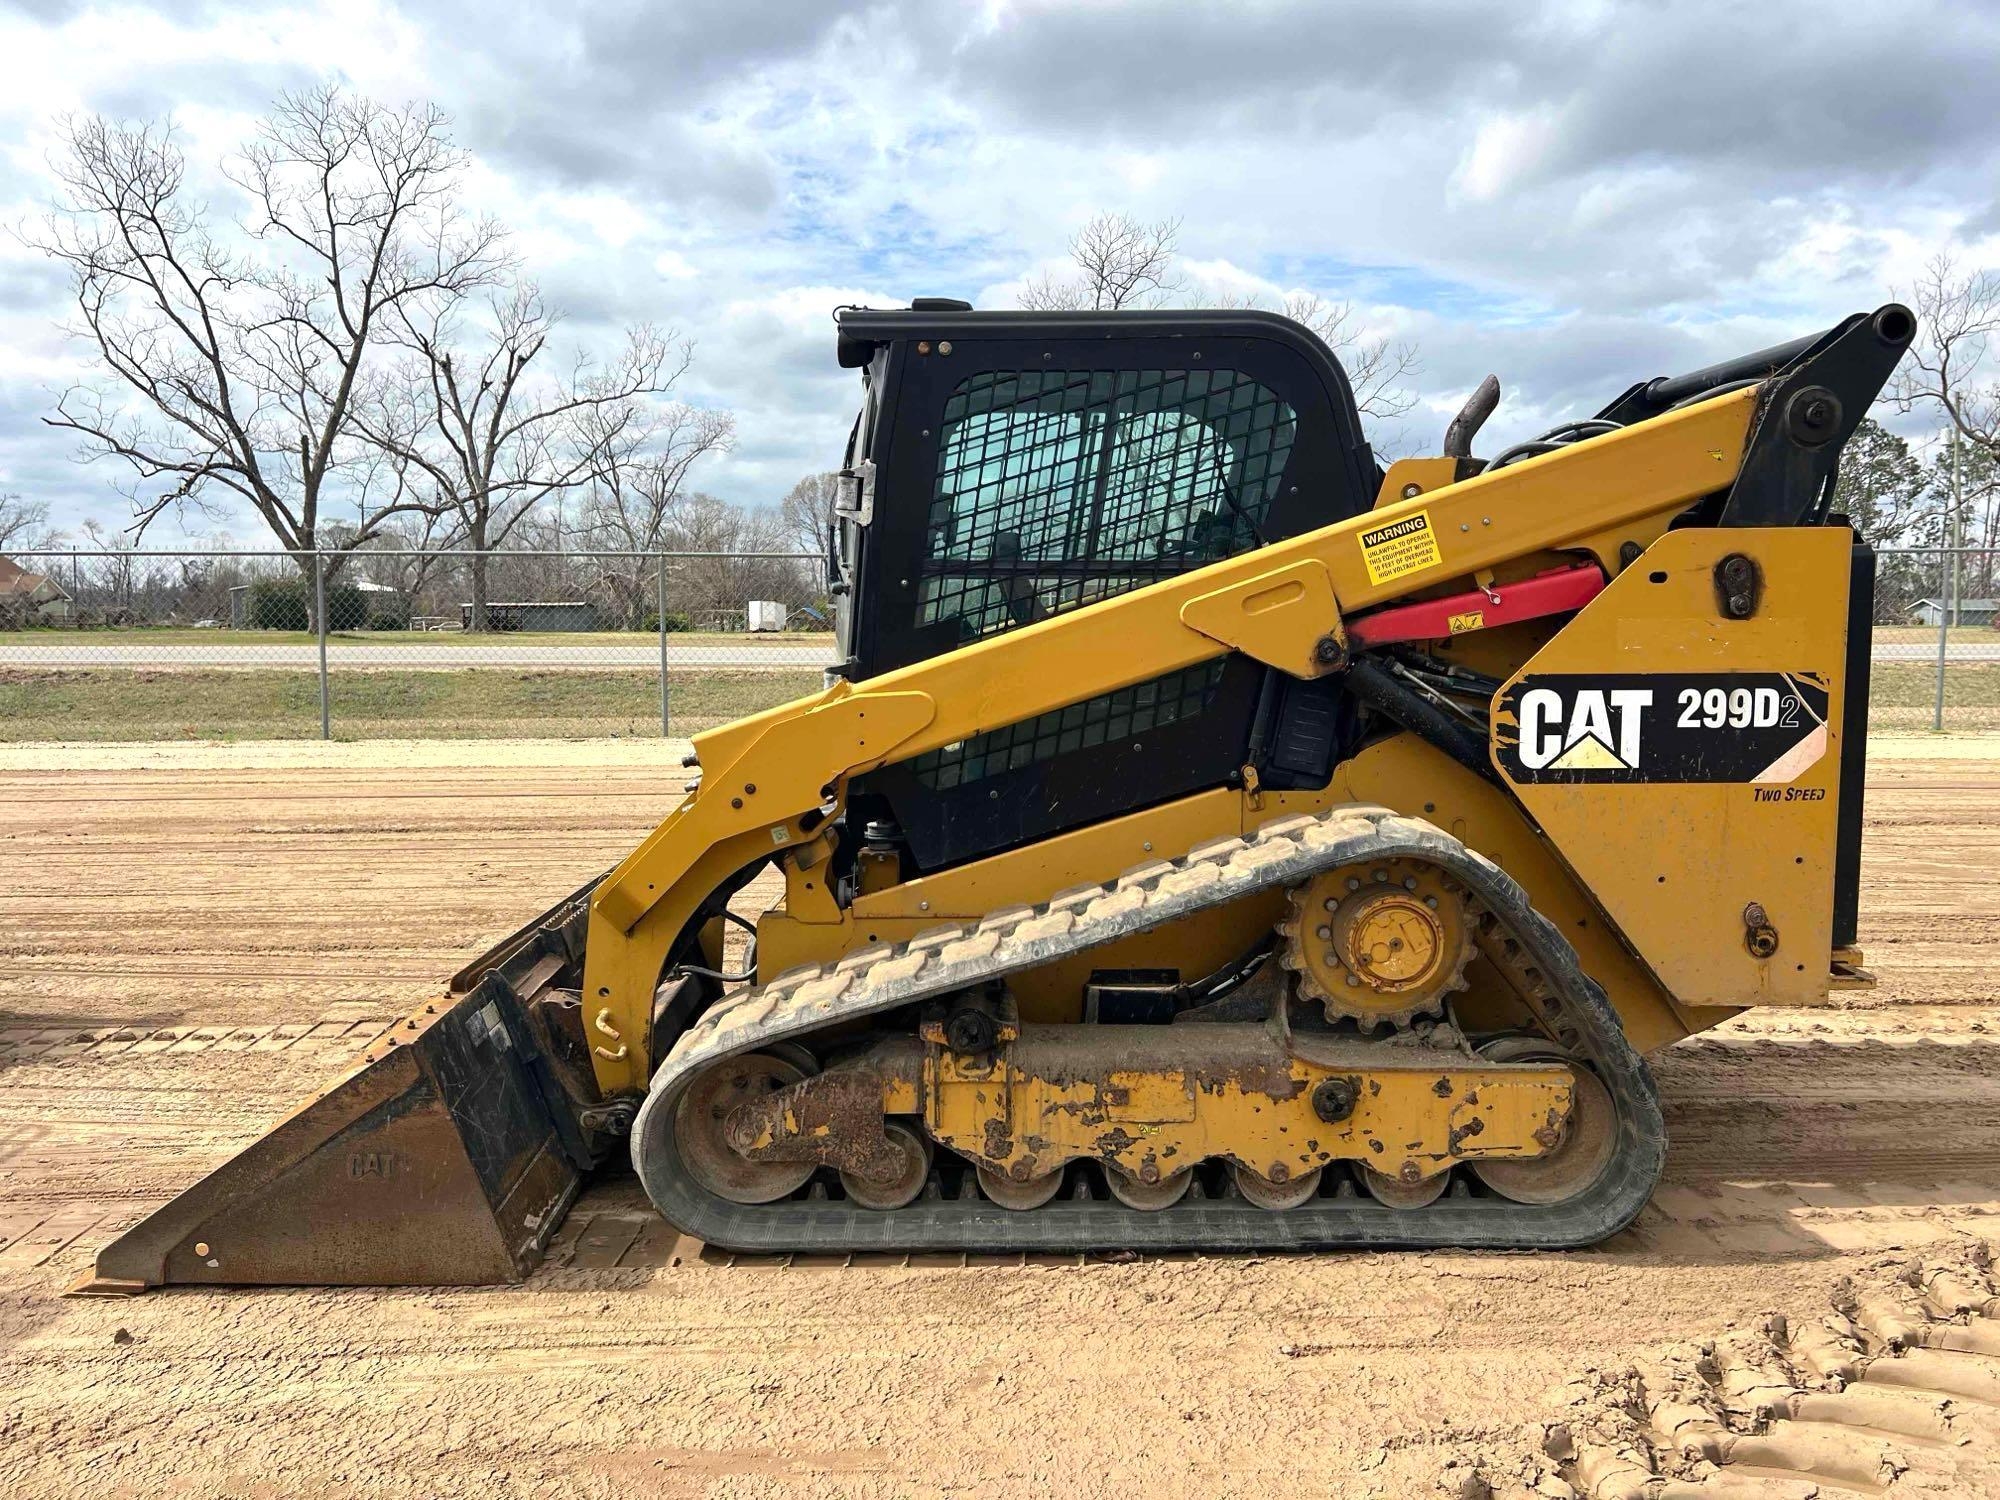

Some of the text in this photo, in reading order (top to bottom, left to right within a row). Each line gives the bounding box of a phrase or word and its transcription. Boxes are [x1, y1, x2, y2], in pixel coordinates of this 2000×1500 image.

[1364, 518, 1425, 546] WARNING
[1367, 533, 1430, 559] UNLAWFUL TO OPERATE
[1369, 539, 1434, 566] THIS EQUIPMENT WITHIN
[1381, 560, 1395, 570] FEET
[1396, 557, 1404, 565] OF
[1404, 547, 1434, 561] OVERHEAD
[1378, 555, 1434, 578] HIGH VOLTAGE LINES
[1519, 688, 1653, 769] CAT
[347, 1152, 395, 1182] CAT
